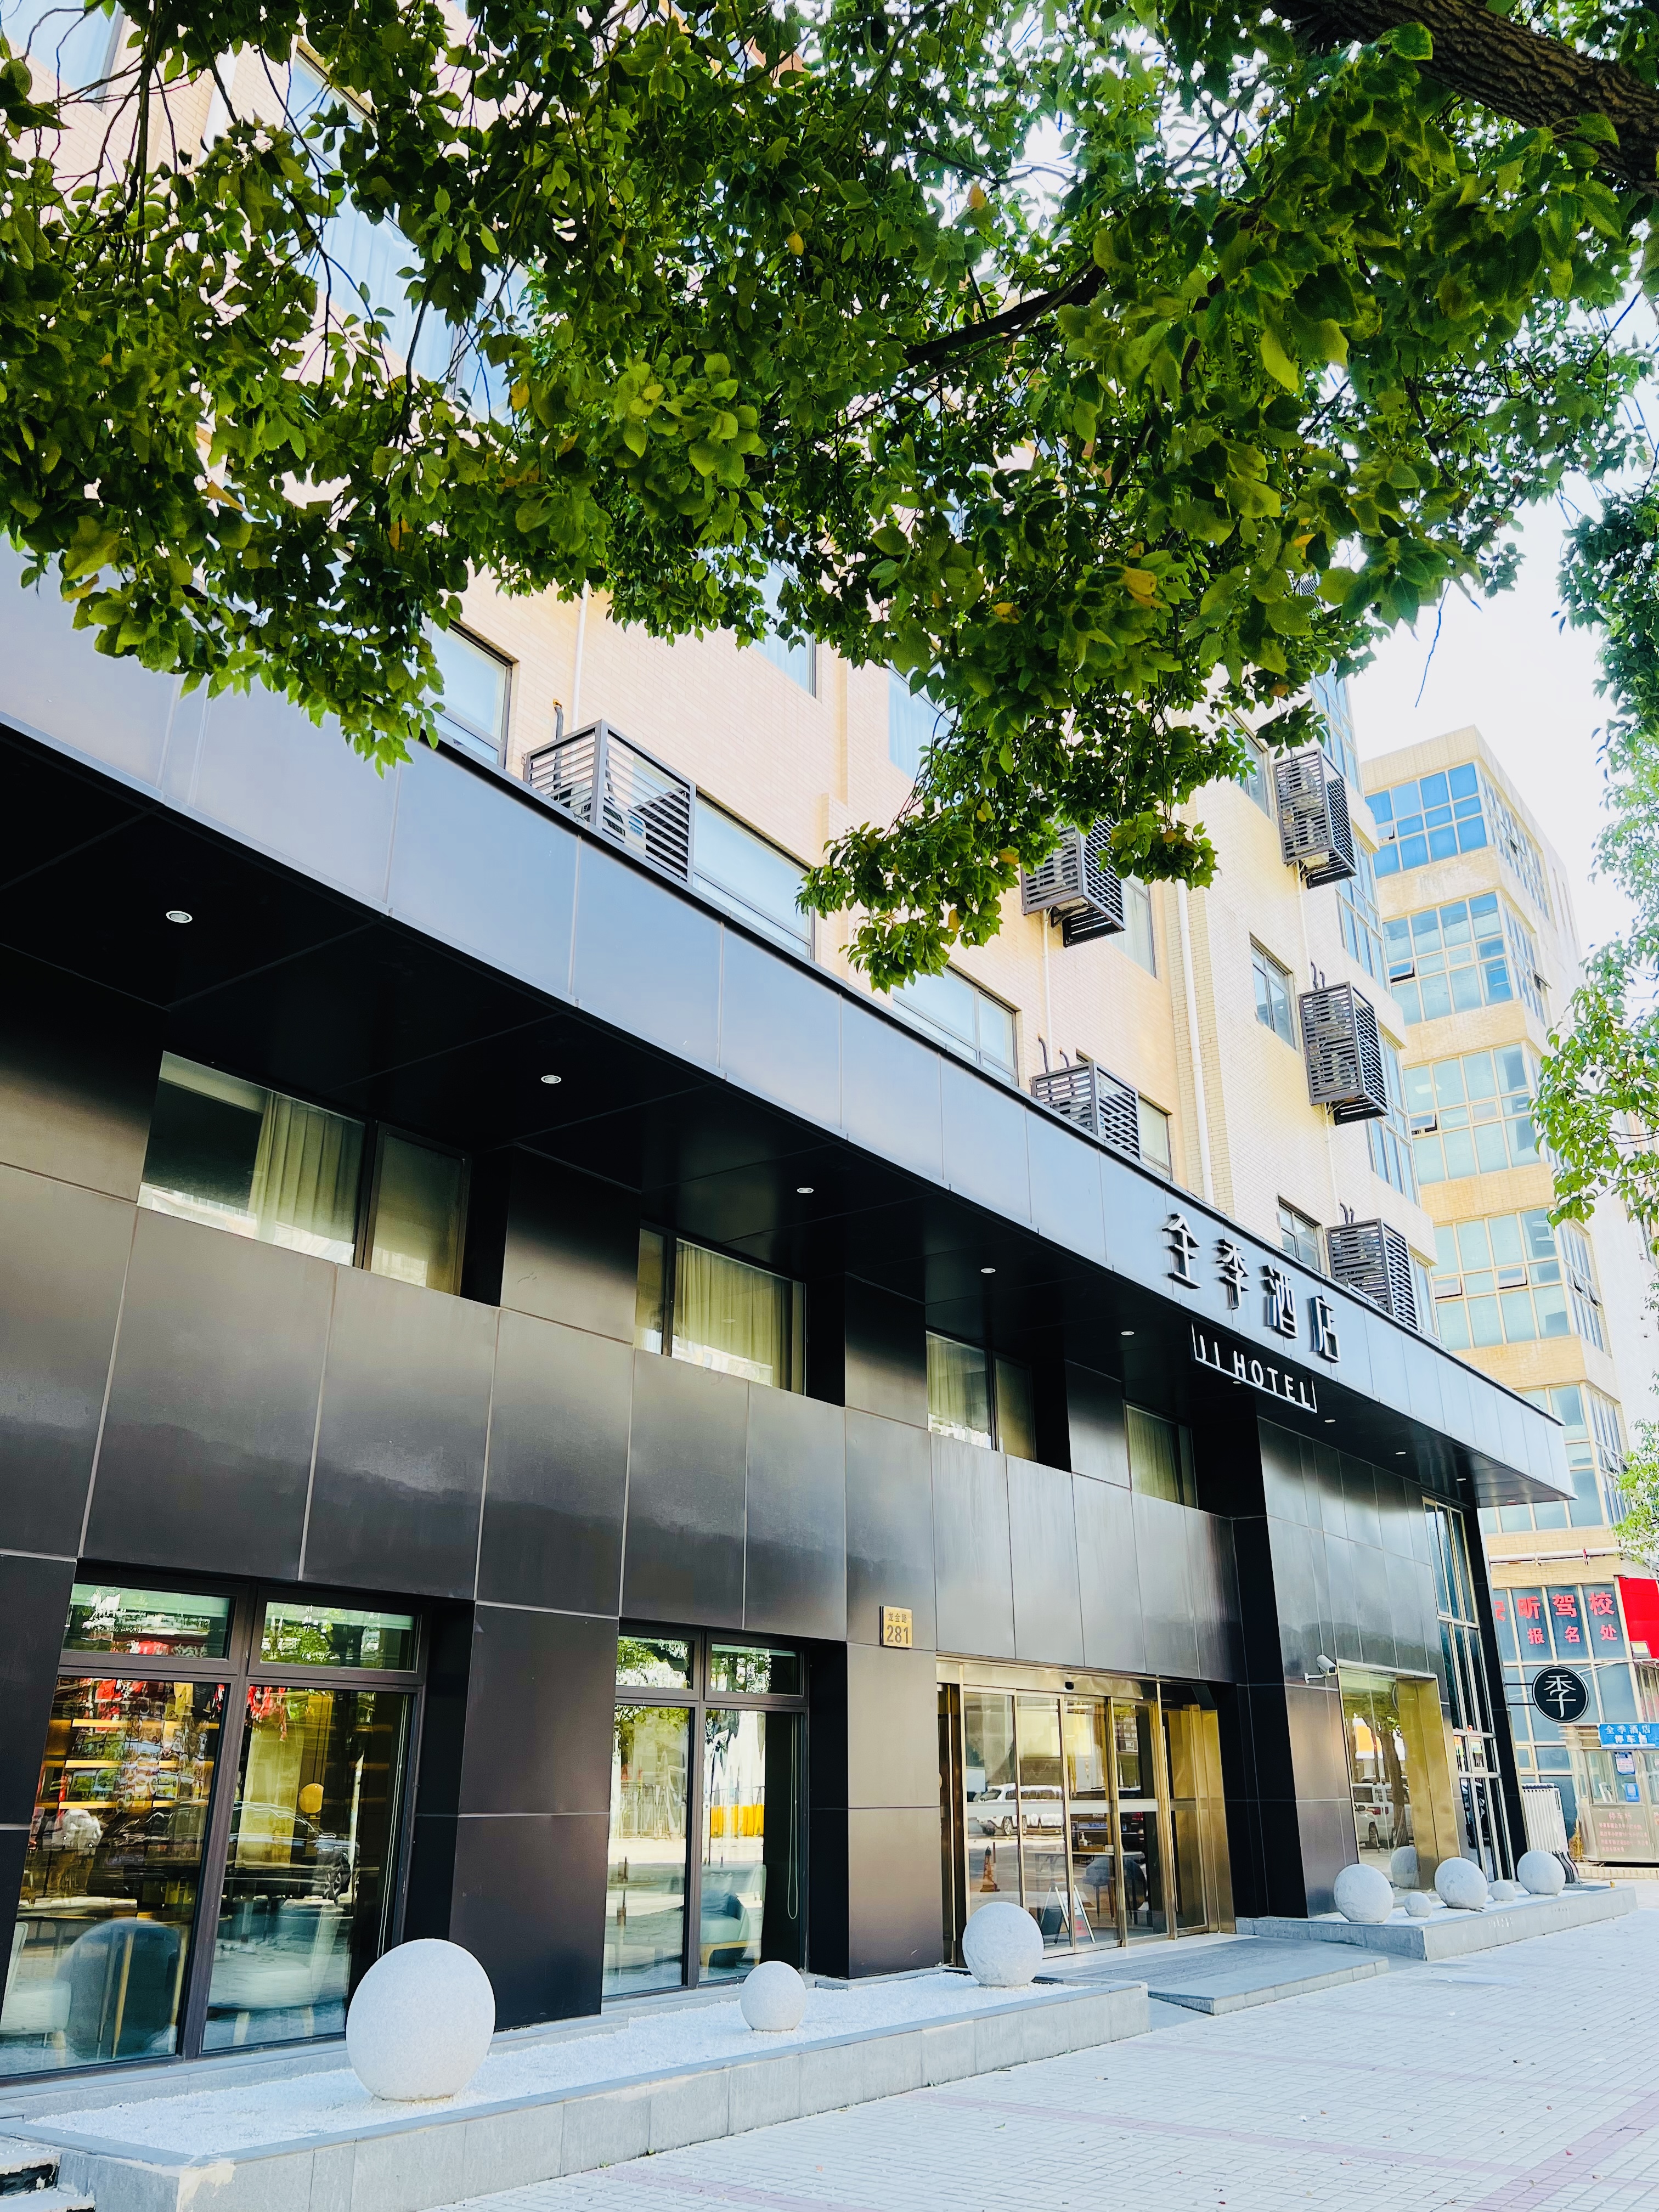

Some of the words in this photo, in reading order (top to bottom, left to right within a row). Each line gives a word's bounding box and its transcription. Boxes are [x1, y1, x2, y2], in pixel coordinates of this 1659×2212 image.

[1162, 1212, 1340, 1363] 全季酒店
[1199, 1335, 1221, 1368] JI
[1233, 1350, 1311, 1408] HOTEL
[887, 1624, 909, 1644] 281
[1527, 1624, 1618, 1645] 报名处
[1543, 1674, 1577, 1718] 季
[1605, 1724, 1651, 1734] 全季酒店
